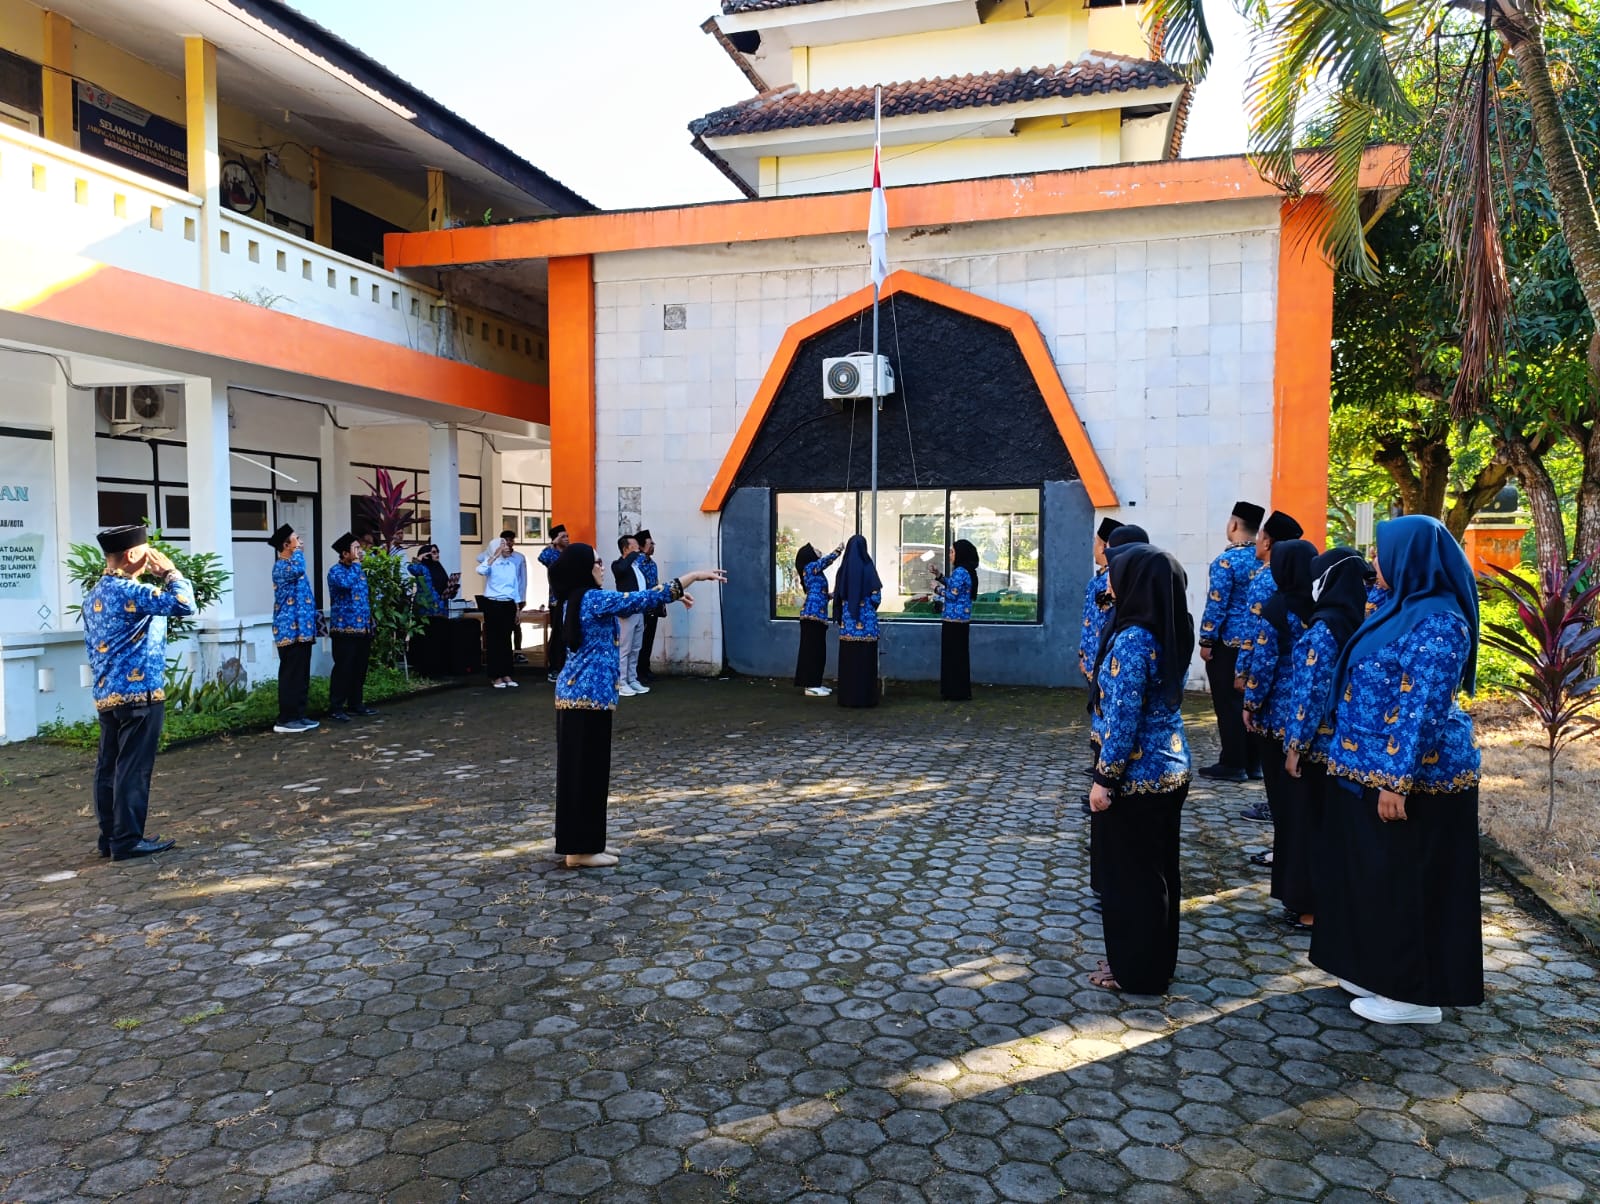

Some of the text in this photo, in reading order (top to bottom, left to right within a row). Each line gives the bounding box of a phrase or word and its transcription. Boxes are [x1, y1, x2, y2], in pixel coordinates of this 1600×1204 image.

[87, 124, 116, 141] JARINGAN
[99, 118, 136, 140] SELAMAT
[138, 134, 169, 155] DATANG
[0, 485, 29, 502] AN
[0, 519, 24, 528] AB/KOTA
